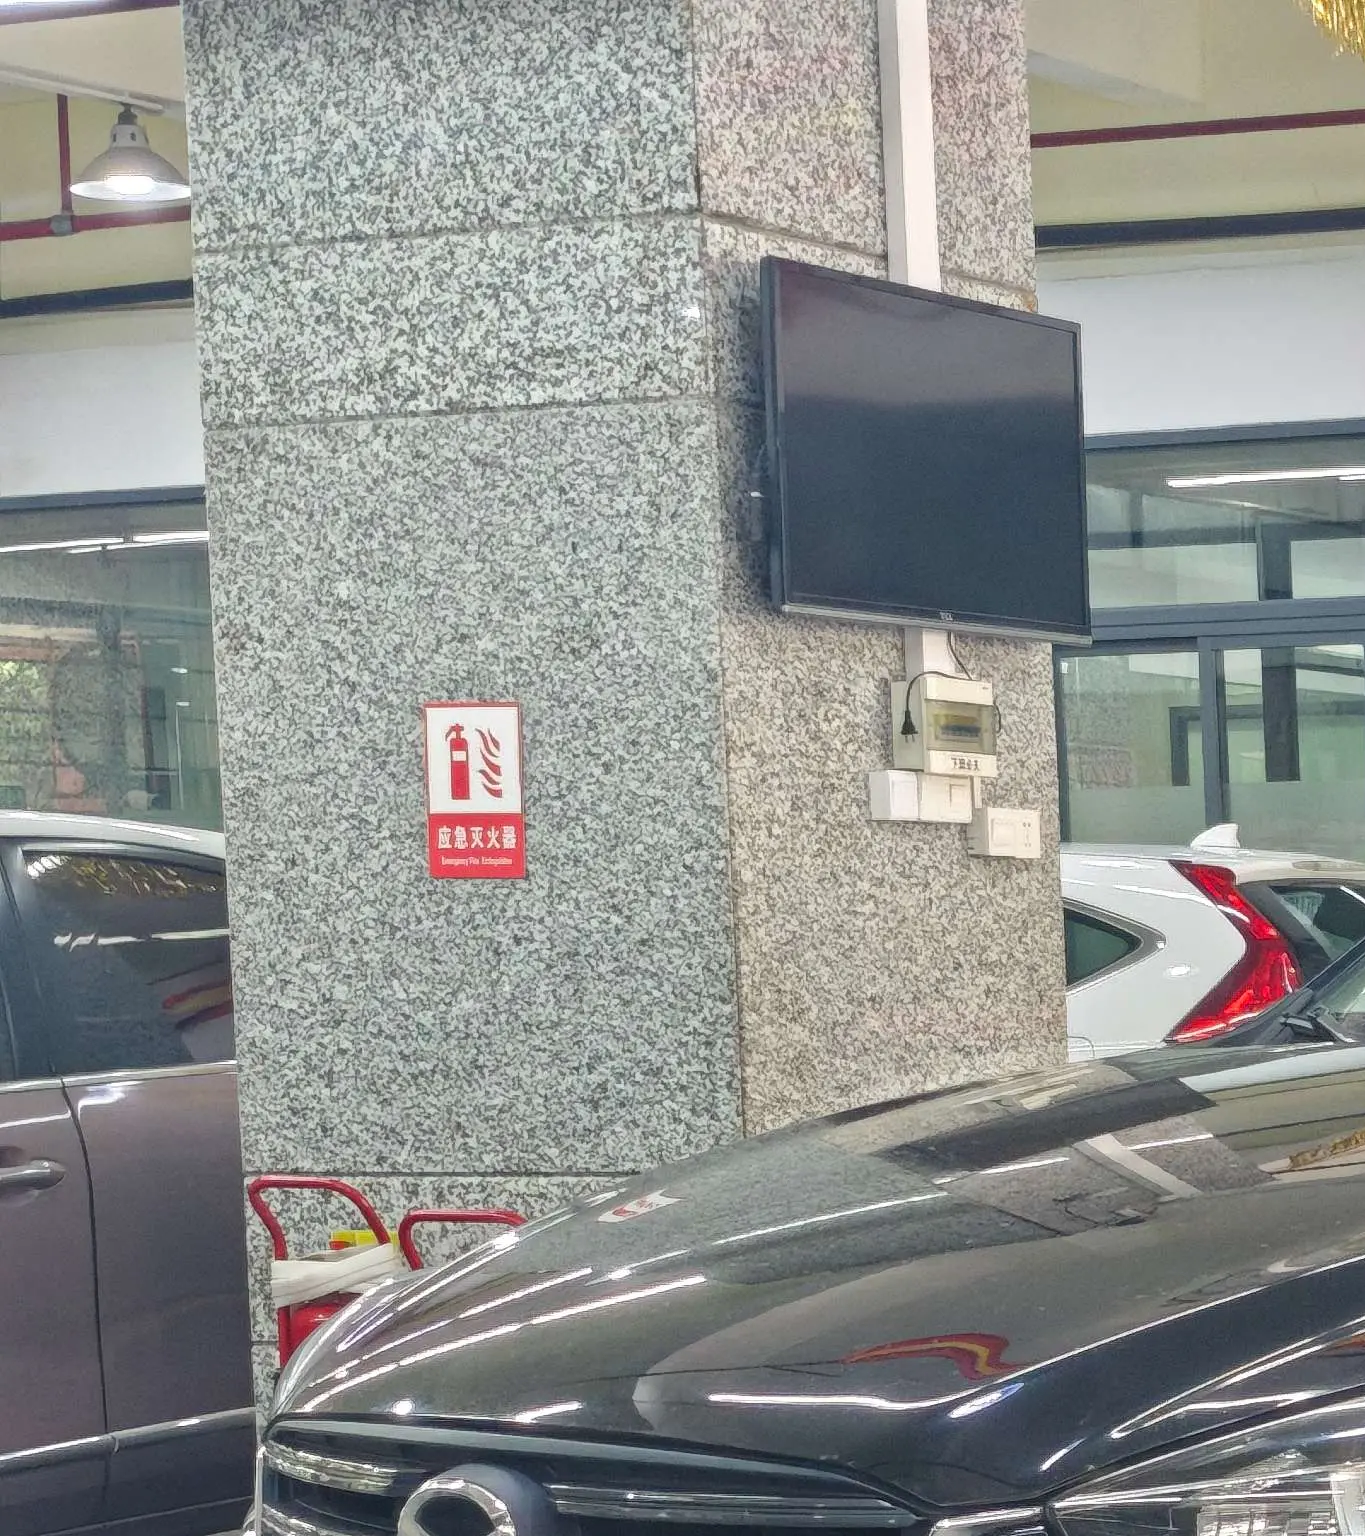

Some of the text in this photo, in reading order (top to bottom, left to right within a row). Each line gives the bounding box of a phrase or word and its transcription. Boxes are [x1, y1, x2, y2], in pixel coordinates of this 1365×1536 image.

[437, 825, 517, 849] 应急灭火器
